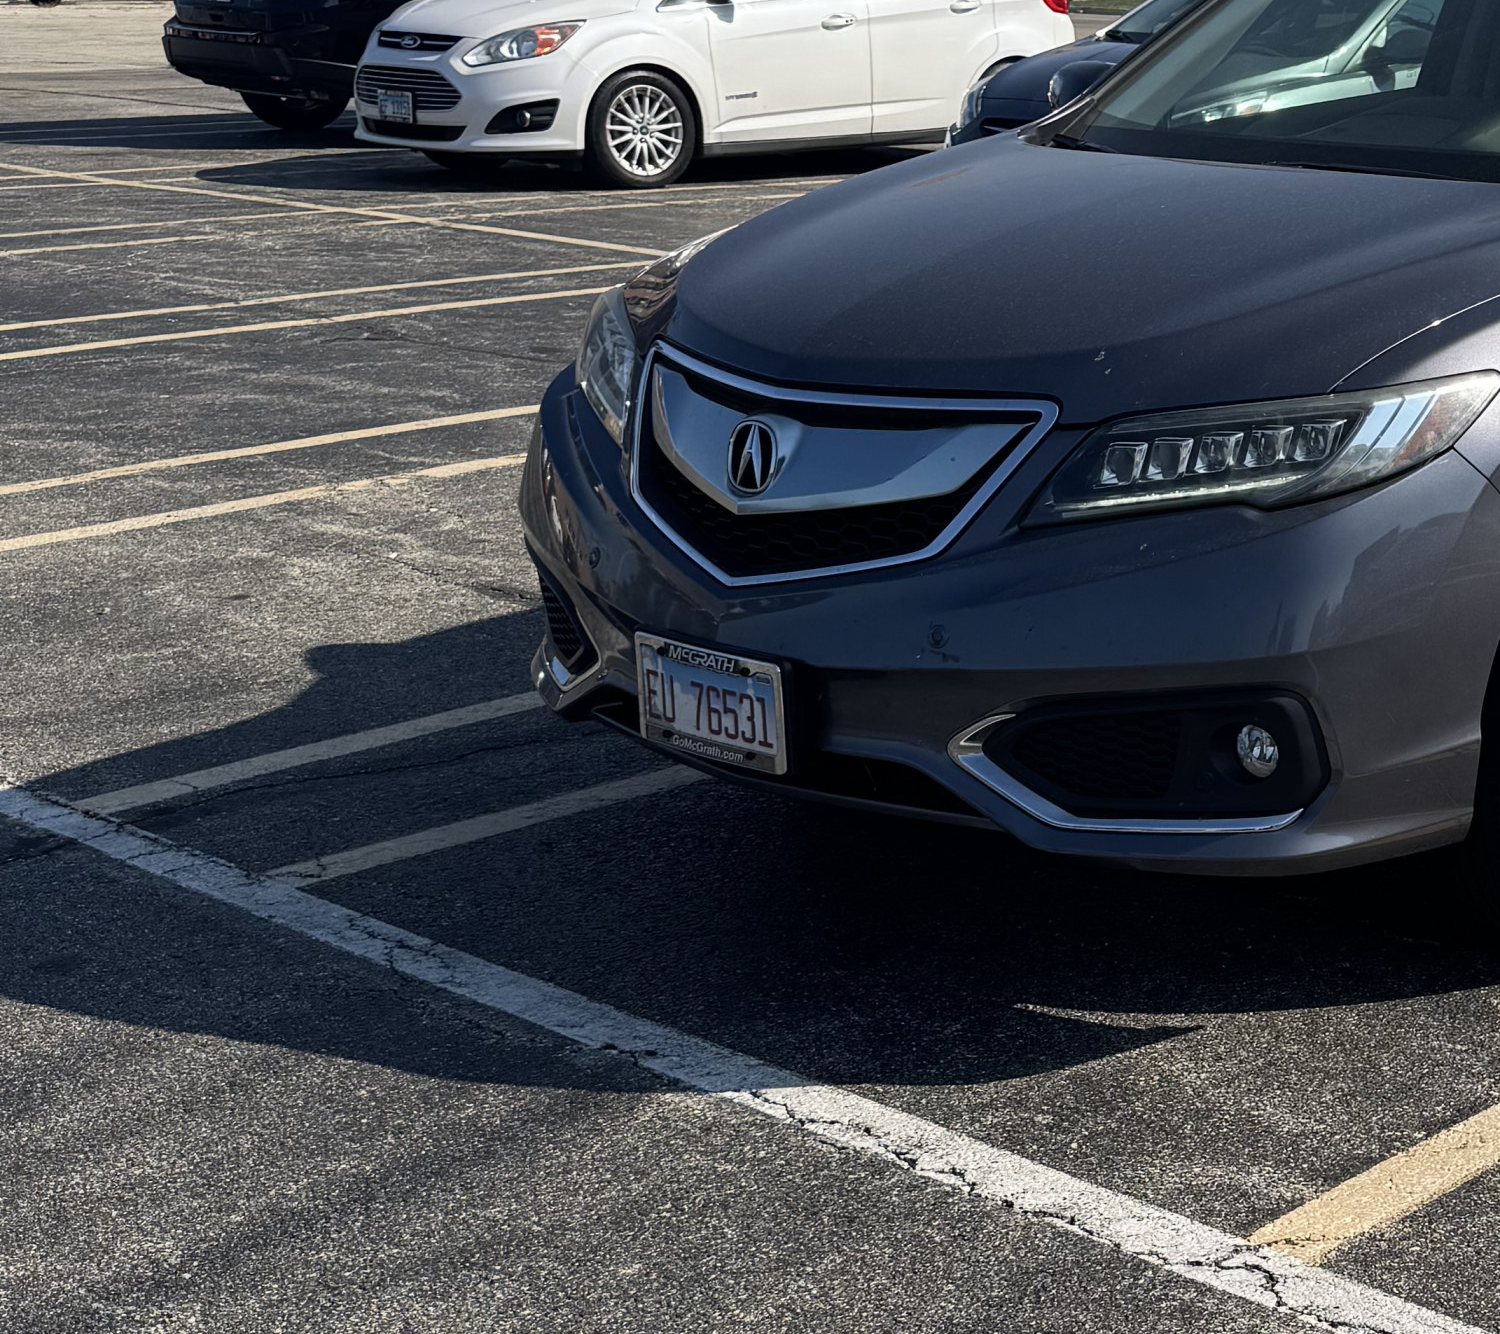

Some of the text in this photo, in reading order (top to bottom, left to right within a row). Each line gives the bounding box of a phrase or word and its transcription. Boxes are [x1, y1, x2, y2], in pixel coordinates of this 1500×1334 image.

[646, 668, 774, 749] EU 76531
[672, 734, 744, 763] GoMcGrath.com
